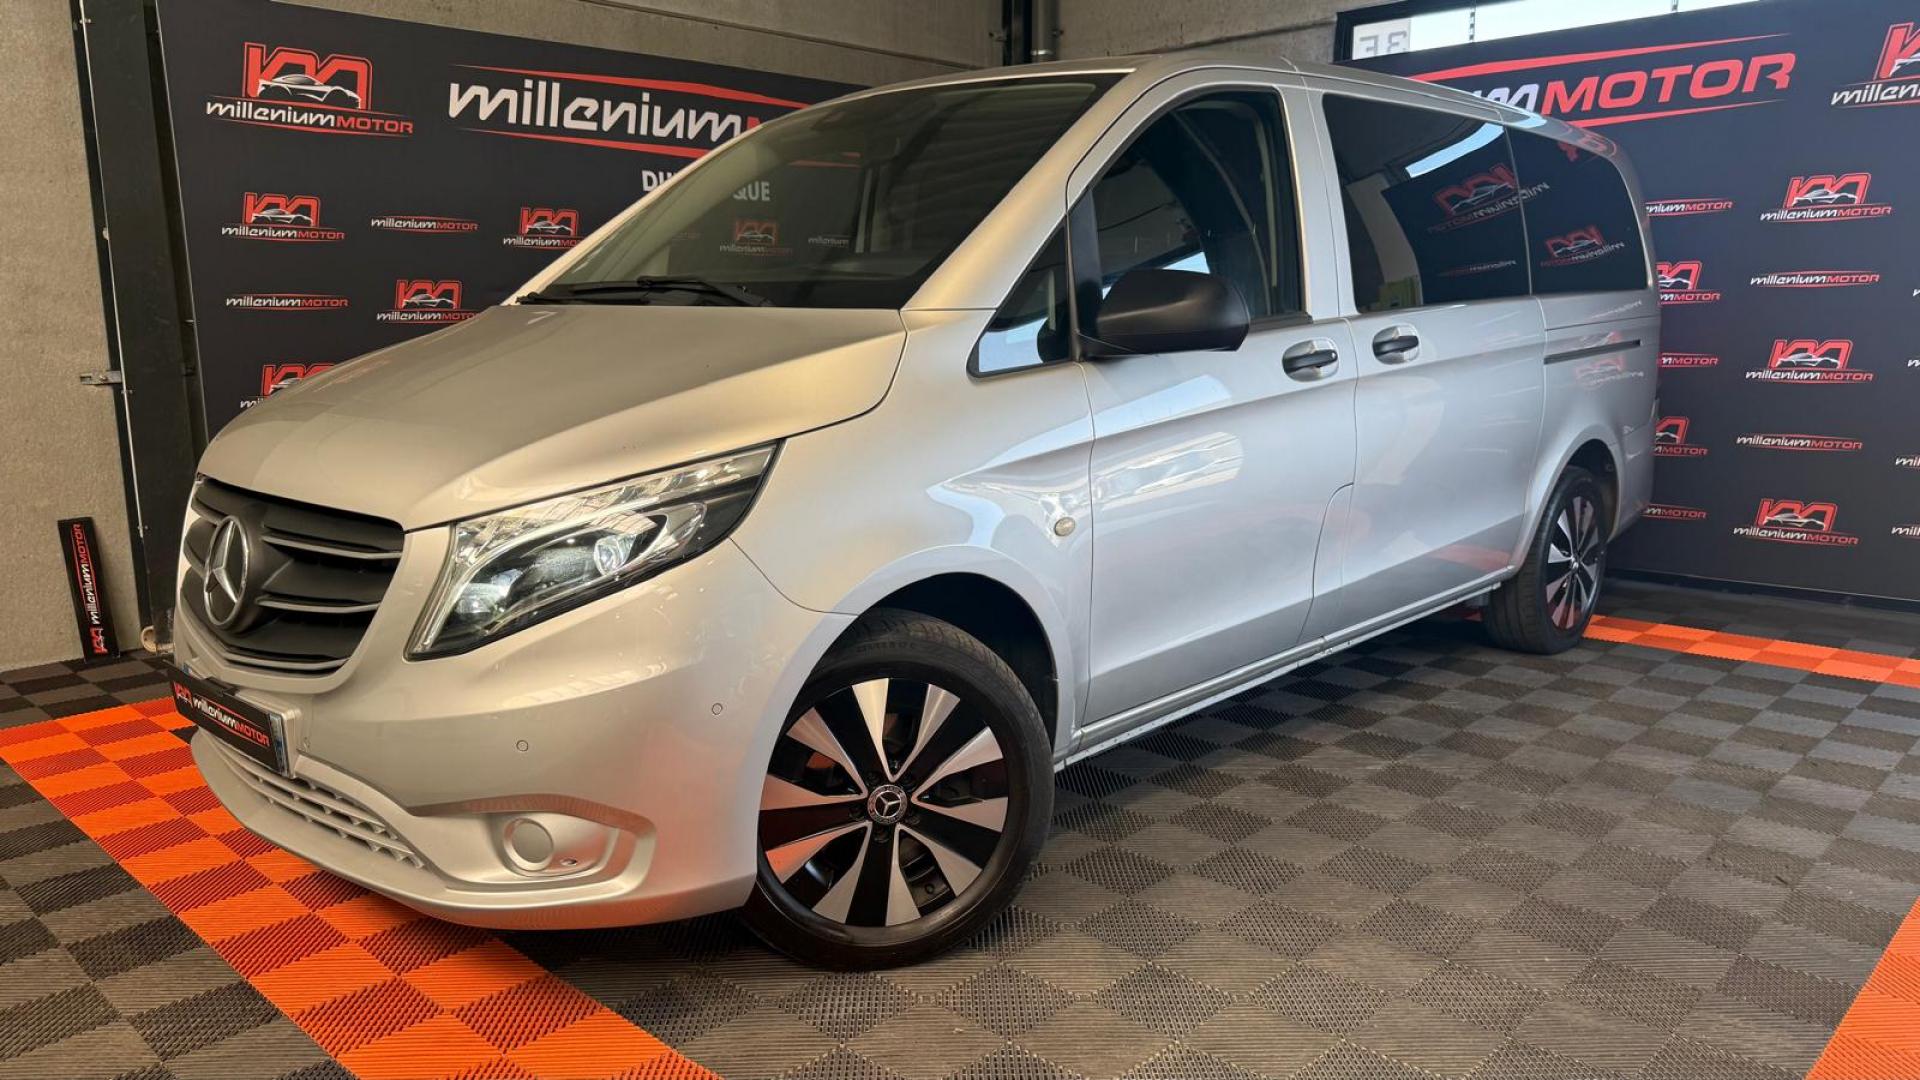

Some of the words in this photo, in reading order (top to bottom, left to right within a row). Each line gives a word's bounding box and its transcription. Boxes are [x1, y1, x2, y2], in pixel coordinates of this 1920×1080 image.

[205, 100, 414, 135] milleniumMOTOR
[1760, 205, 1892, 221] milleniumMOTOR
[371, 217, 479, 232] milleniumMOTOR
[221, 225, 345, 241] milleniumMOTOR
[1750, 273, 1880, 286] milleniumMOTOR
[226, 294, 349, 308] milleniumMOTOR
[1745, 369, 1874, 382] milleniumMOTOR
[1736, 435, 1863, 450] milleniumMOTOR
[1733, 525, 1859, 546] milleniumMOTOR
